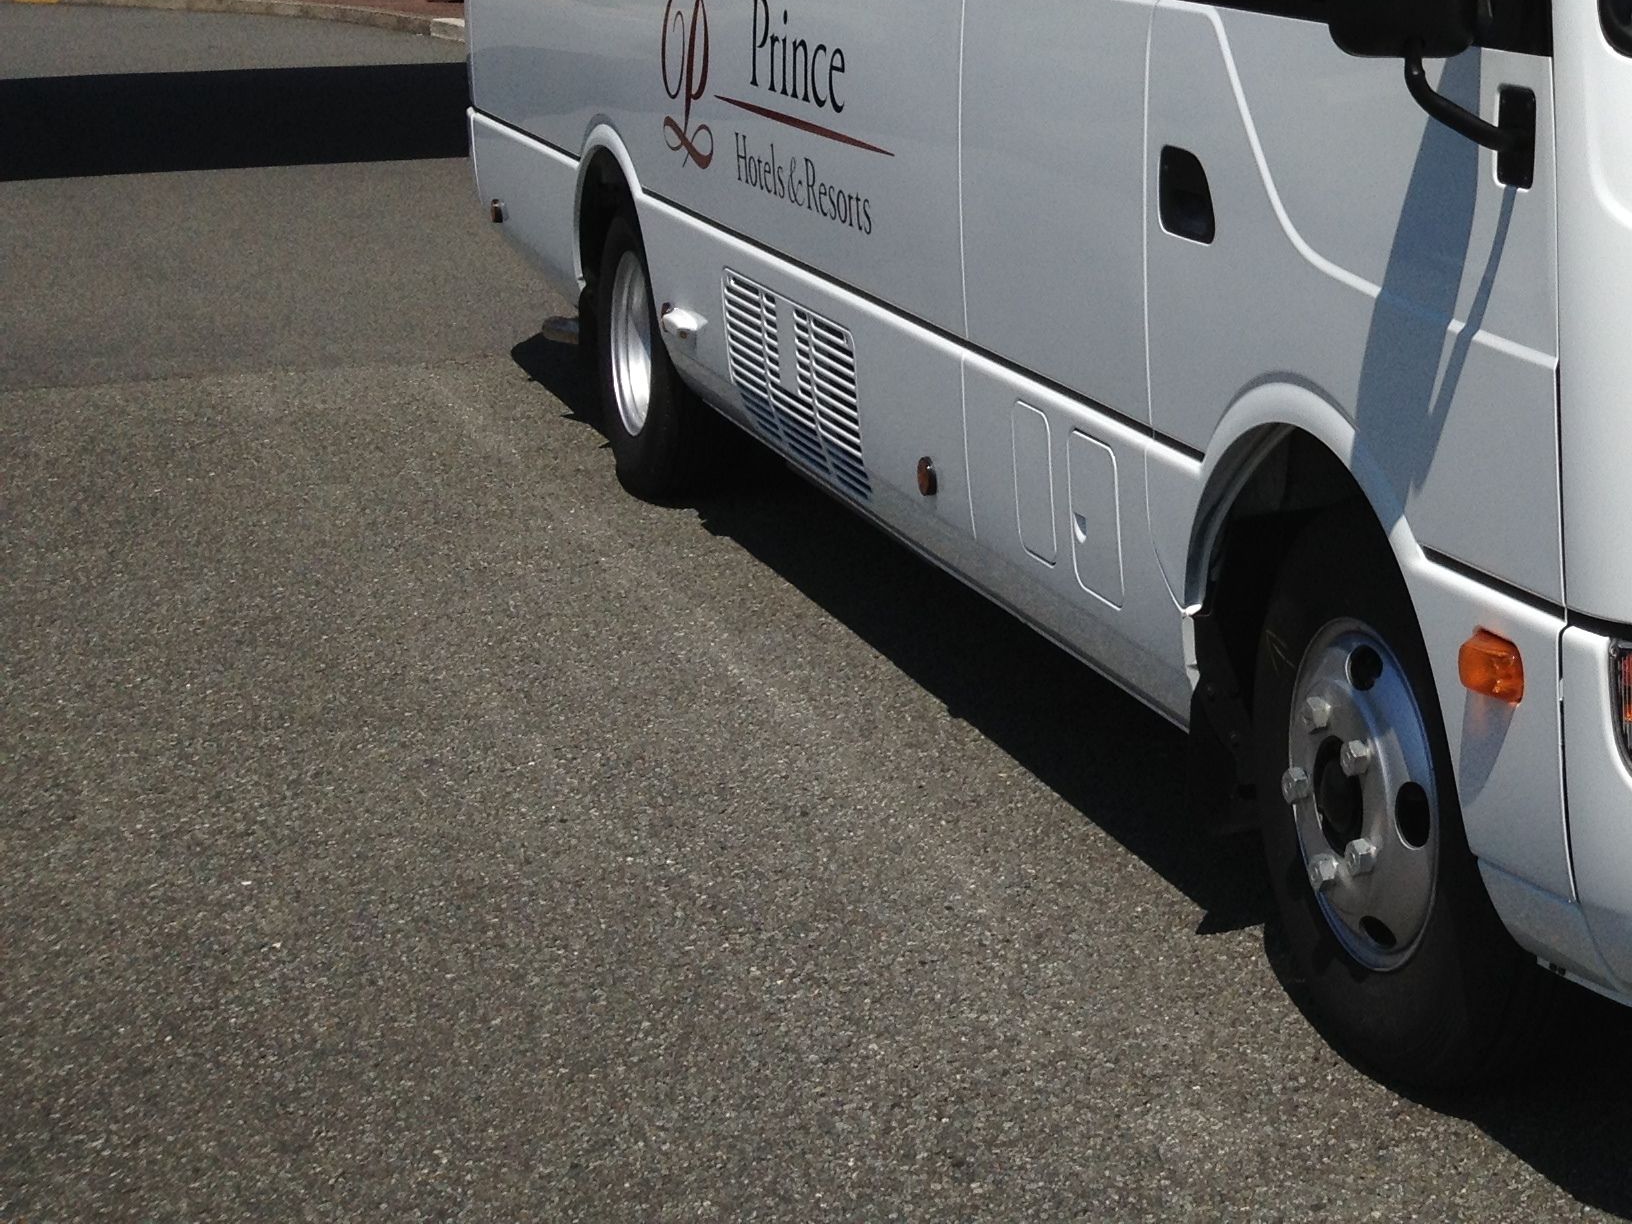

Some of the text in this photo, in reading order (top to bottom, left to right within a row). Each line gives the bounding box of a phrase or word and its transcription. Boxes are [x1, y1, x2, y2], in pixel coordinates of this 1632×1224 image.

[734, 132, 873, 235] Hotels & Resorts
